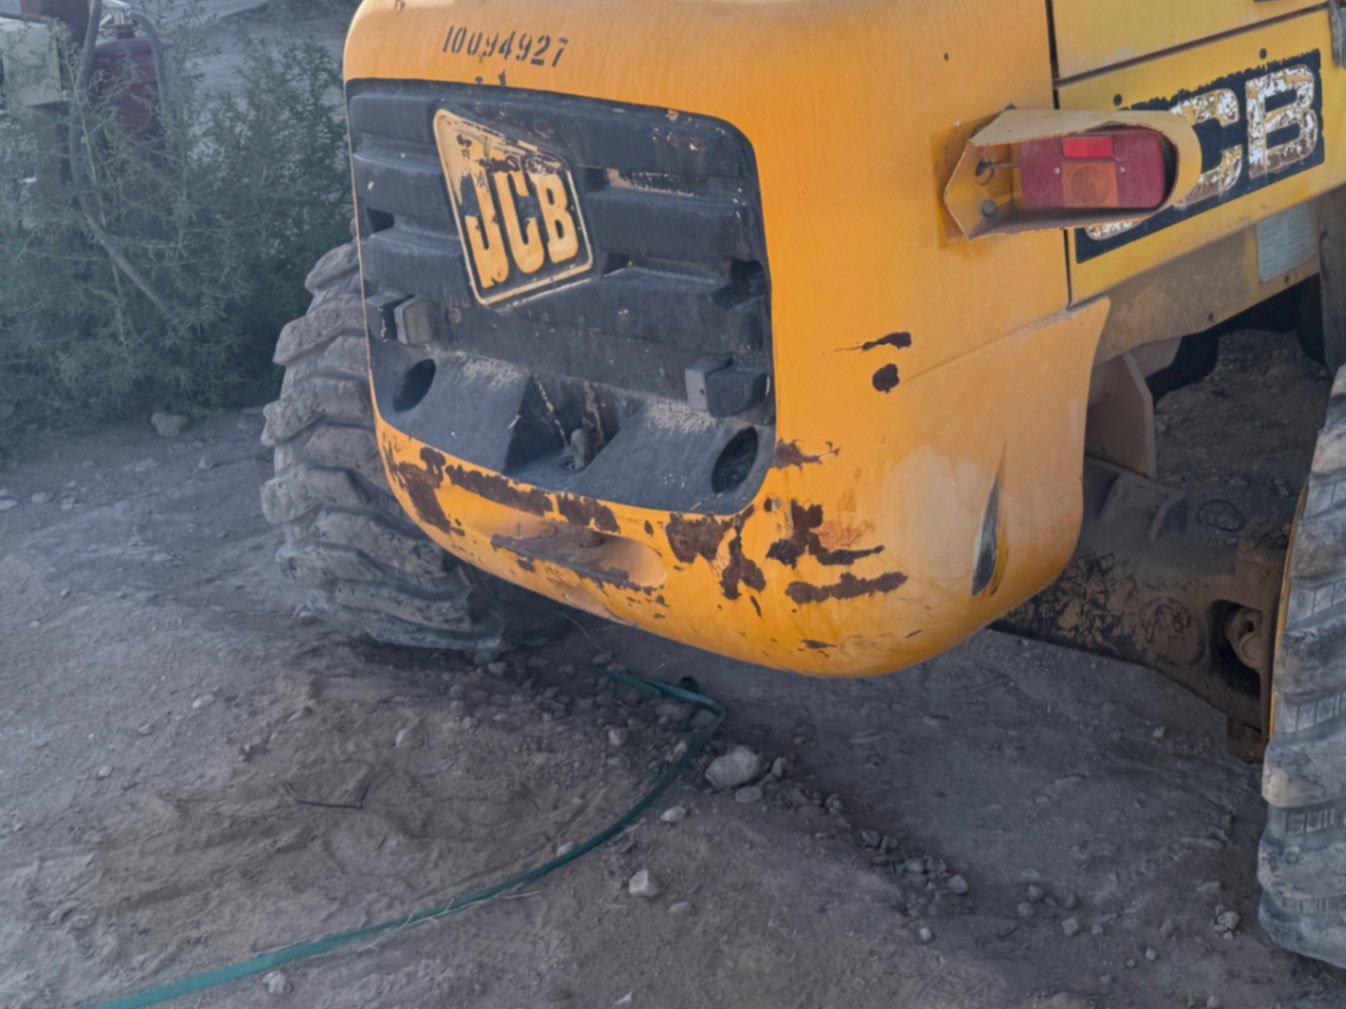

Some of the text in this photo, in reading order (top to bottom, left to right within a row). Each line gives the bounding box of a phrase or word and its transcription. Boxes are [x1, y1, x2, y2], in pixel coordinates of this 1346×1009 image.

[442, 25, 569, 68] 10094927
[463, 147, 580, 289] JCB
[1086, 63, 1318, 241] CB
